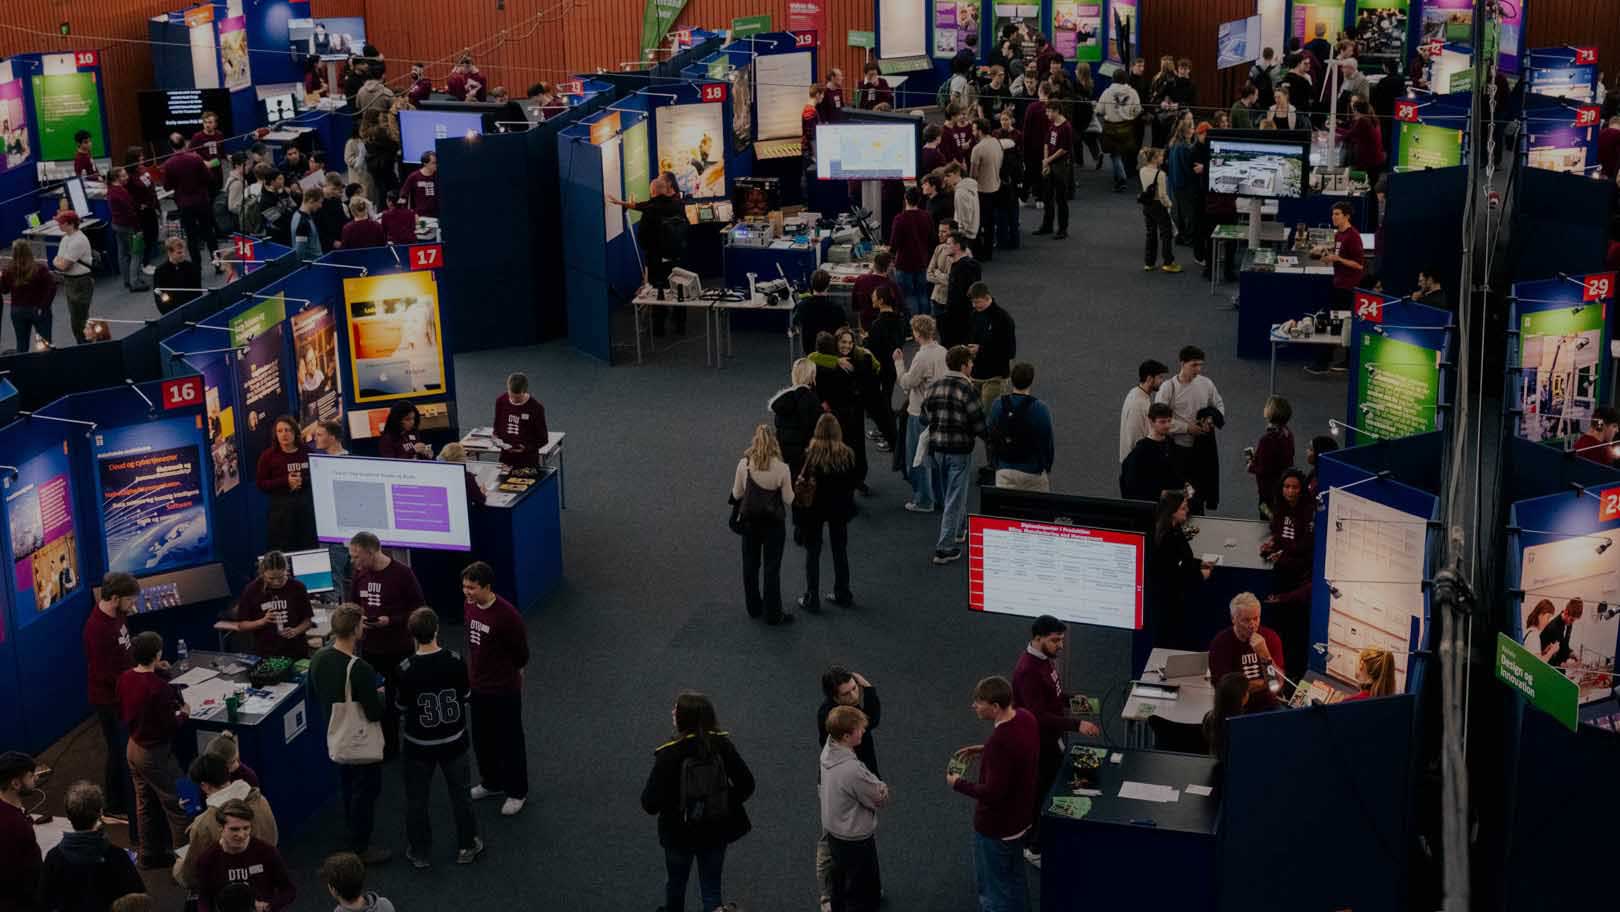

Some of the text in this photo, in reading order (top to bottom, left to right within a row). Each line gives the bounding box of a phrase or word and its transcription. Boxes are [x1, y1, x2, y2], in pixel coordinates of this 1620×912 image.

[797, 34, 812, 46] 19
[78, 53, 93, 64] 10
[706, 87, 721, 98] 18
[1580, 110, 1596, 122] 30
[417, 249, 437, 264] 17
[1589, 279, 1609, 296] 29
[1358, 299, 1377, 318] 24
[170, 383, 195, 403] 16
[368, 582, 381, 593] DTU
[272, 600, 287, 610] DTU
[1242, 653, 1258, 665] DTU
[1502, 655, 1534, 686] Design og
[1501, 667, 1535, 698] Innovation
[417, 688, 460, 728] 36
[228, 867, 249, 881] DTU
